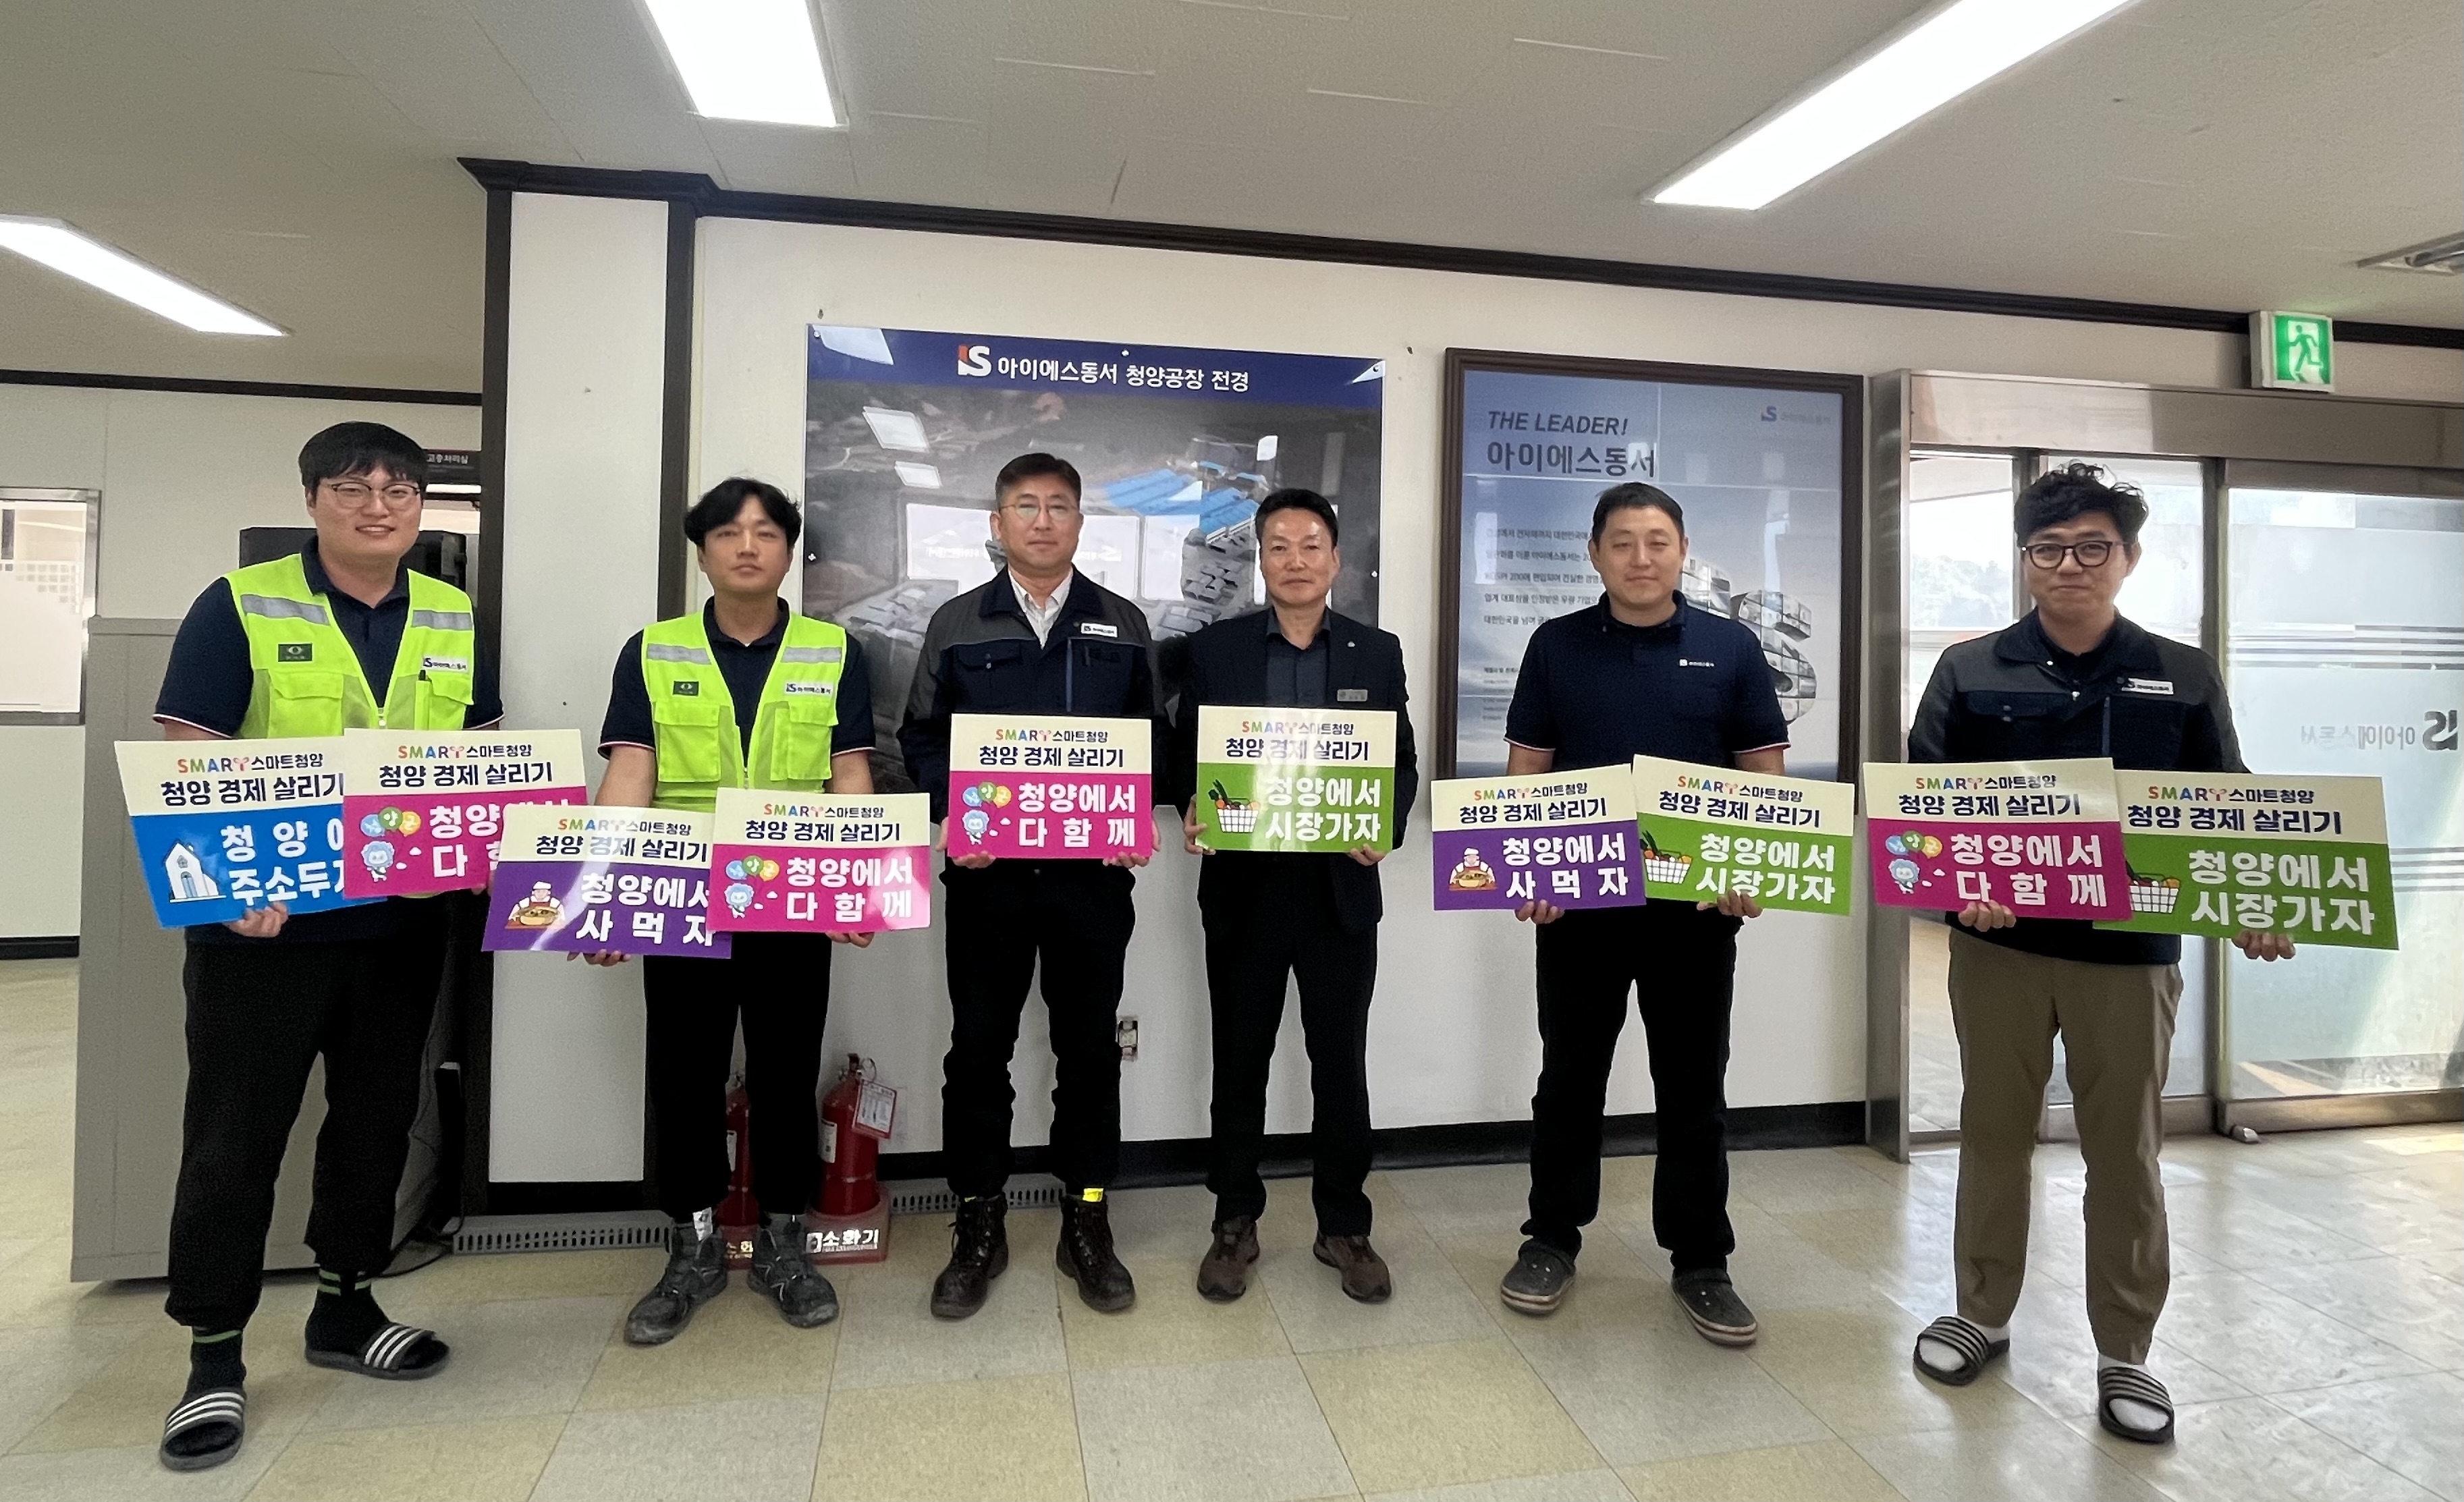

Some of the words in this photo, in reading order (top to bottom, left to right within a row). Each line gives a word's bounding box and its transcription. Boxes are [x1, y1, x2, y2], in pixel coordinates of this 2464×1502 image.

[997, 357, 1118, 384] 아이에스동서
[1126, 364, 1205, 389] 청양공장
[1211, 370, 1249, 392] 전경
[1488, 411, 1529, 430] THE
[1535, 413, 1628, 435] LEADER!
[1487, 442, 1654, 478] 아이에스동서
[1052, 731, 1108, 742] 스마트청양
[1298, 723, 1354, 735] 스마트청양
[252, 753, 323, 771] 스마트청양
[466, 744, 532, 758] 스마트청양
[980, 746, 1018, 766] 청양
[1024, 747, 1062, 767] 경제
[1068, 748, 1123, 767] 살리기
[1226, 738, 1263, 758] 청양
[1270, 739, 1307, 760] 경제
[1315, 741, 1368, 761] 살리기
[379, 765, 426, 787] 청양
[434, 765, 478, 786] 경제
[485, 762, 553, 784] 살리기
[1984, 775, 2056, 789] 스마트청양
[161, 781, 211, 806] 청양
[219, 778, 267, 802] 경제
[273, 773, 344, 800] 살리기
[1018, 783, 1135, 813] 청양에서
[1267, 778, 1380, 807] 청양에서
[1531, 782, 1587, 798] 스마트청양
[1739, 785, 1803, 802] 스마트청양
[2228, 789, 2314, 804] 스마트청양
[825, 807, 883, 818] 스마트청양
[1460, 805, 1498, 824] 청양
[1504, 803, 1541, 822] 경제
[1548, 798, 1607, 820] 살리기
[1660, 790, 1701, 814] 청양
[1707, 798, 1749, 820] 경제
[1755, 804, 1820, 828] 살리기
[1899, 795, 1944, 815] 청양
[1952, 796, 1999, 816] 경제
[2006, 794, 2080, 816] 살리기
[626, 821, 691, 835] 스마트청양
[746, 820, 787, 841] 청양
[794, 823, 833, 841] 경제
[841, 823, 900, 841] 살리기
[1265, 812, 1381, 842] 시장가자
[2128, 805, 2181, 829] 청양
[2190, 807, 2245, 831] 경제
[2253, 809, 2341, 835] 살리기
[537, 836, 583, 854] 청양
[591, 836, 635, 856] 경제
[642, 839, 707, 862] 살리기
[1503, 833, 1626, 866] 청양에서
[1701, 833, 1835, 872] 청양에서
[1950, 833, 2102, 868] 청양에서
[787, 857, 912, 888] 청양에서
[2189, 850, 2369, 892] 청양에서
[1695, 868, 1836, 905] 시장가자
[2191, 891, 2375, 935] 시장가자
[823, 1229, 879, 1246] 소화기
